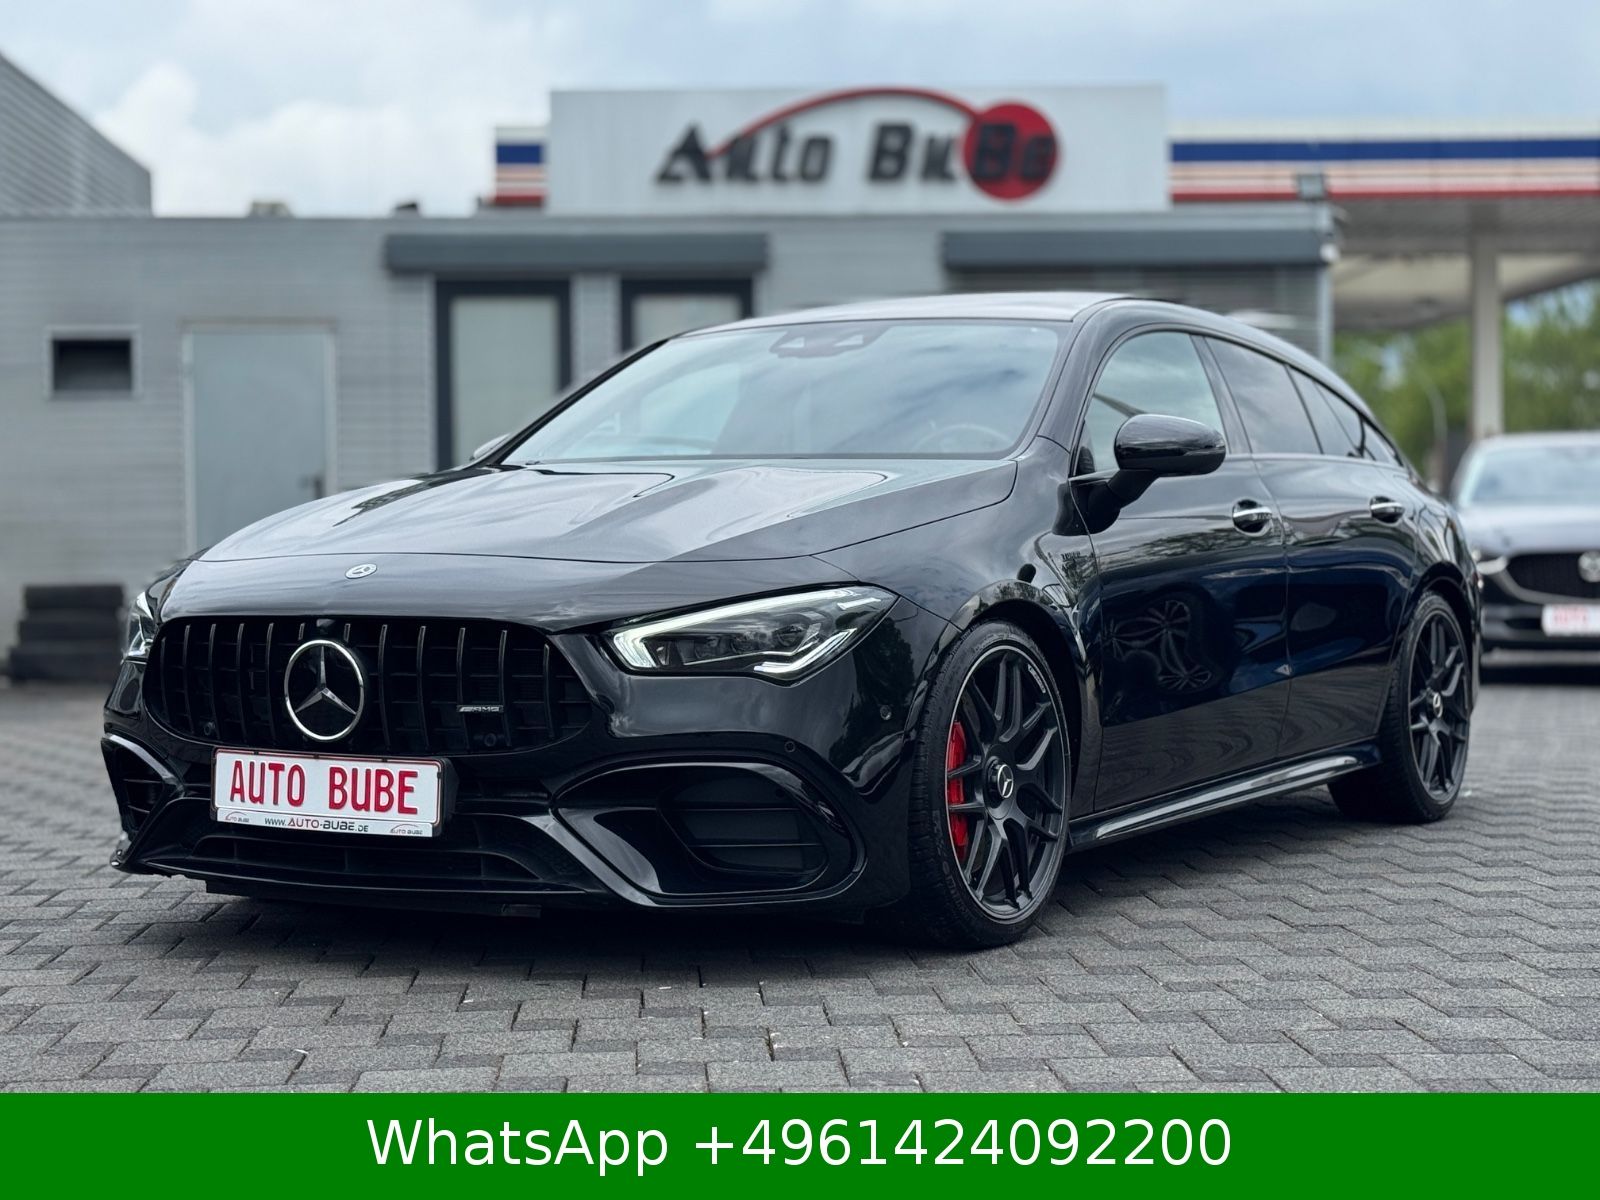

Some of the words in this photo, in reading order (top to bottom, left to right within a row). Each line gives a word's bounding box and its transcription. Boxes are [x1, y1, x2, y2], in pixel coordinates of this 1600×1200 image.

[655, 122, 835, 183] Auto
[230, 760, 305, 807] AUTO
[328, 767, 418, 815] BUBE
